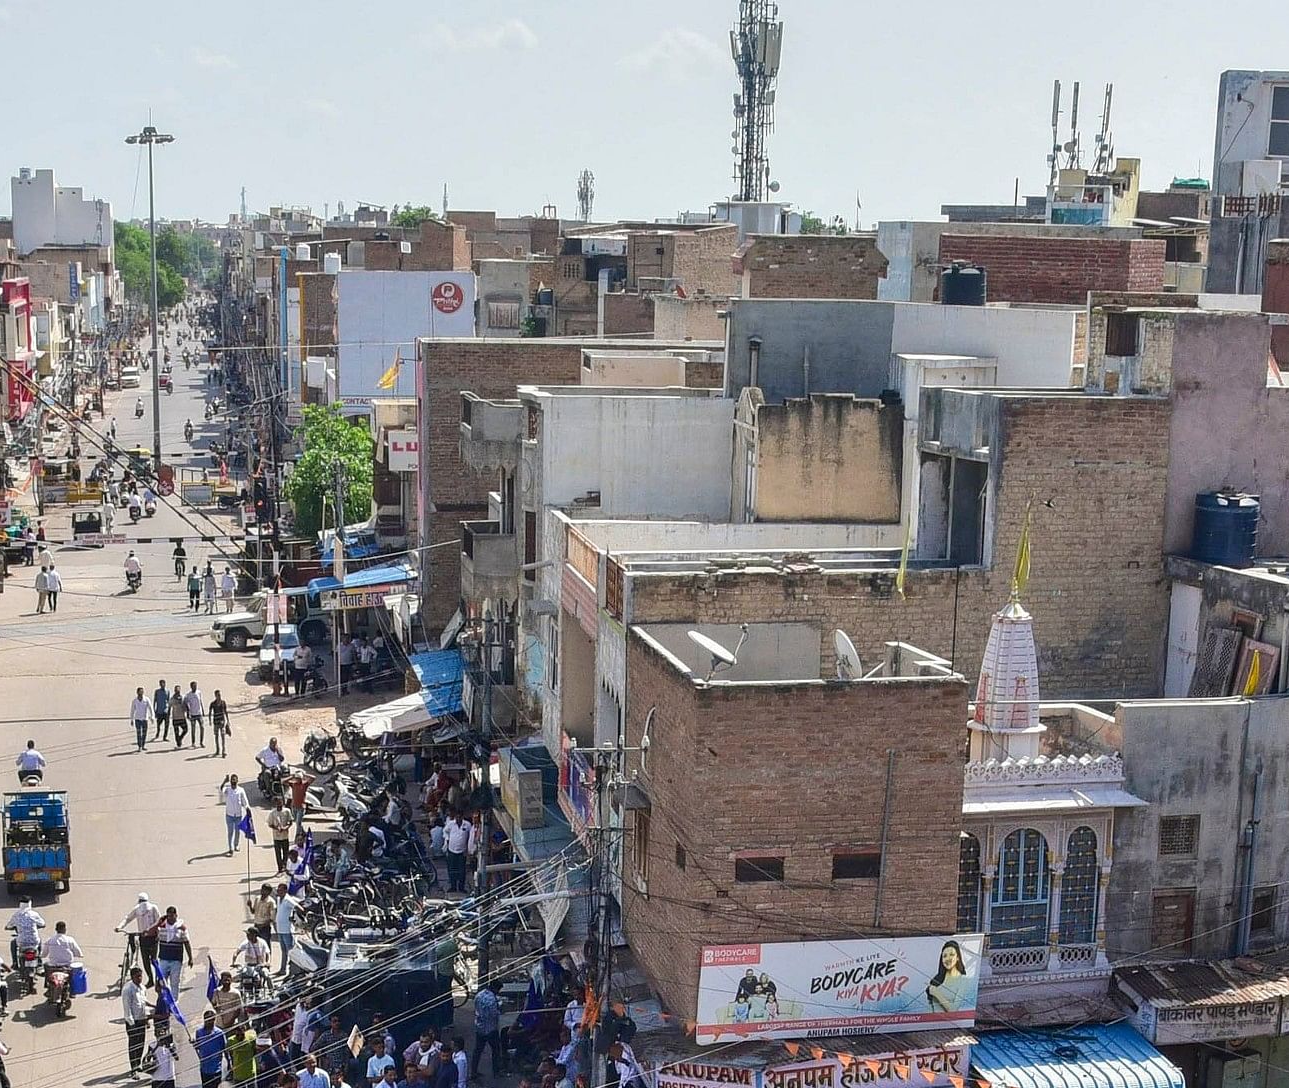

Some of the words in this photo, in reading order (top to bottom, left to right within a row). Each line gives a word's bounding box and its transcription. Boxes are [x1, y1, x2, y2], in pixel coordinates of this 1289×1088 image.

[714, 948, 757, 958] BODYCARE
[810, 958, 898, 995] BODYCARE
[859, 975, 910, 1004] KYA?
[807, 1027, 841, 1037] ANUPAM
[841, 1026, 875, 1036] HOSIERY
[659, 1064, 751, 1085] ANUPAM
